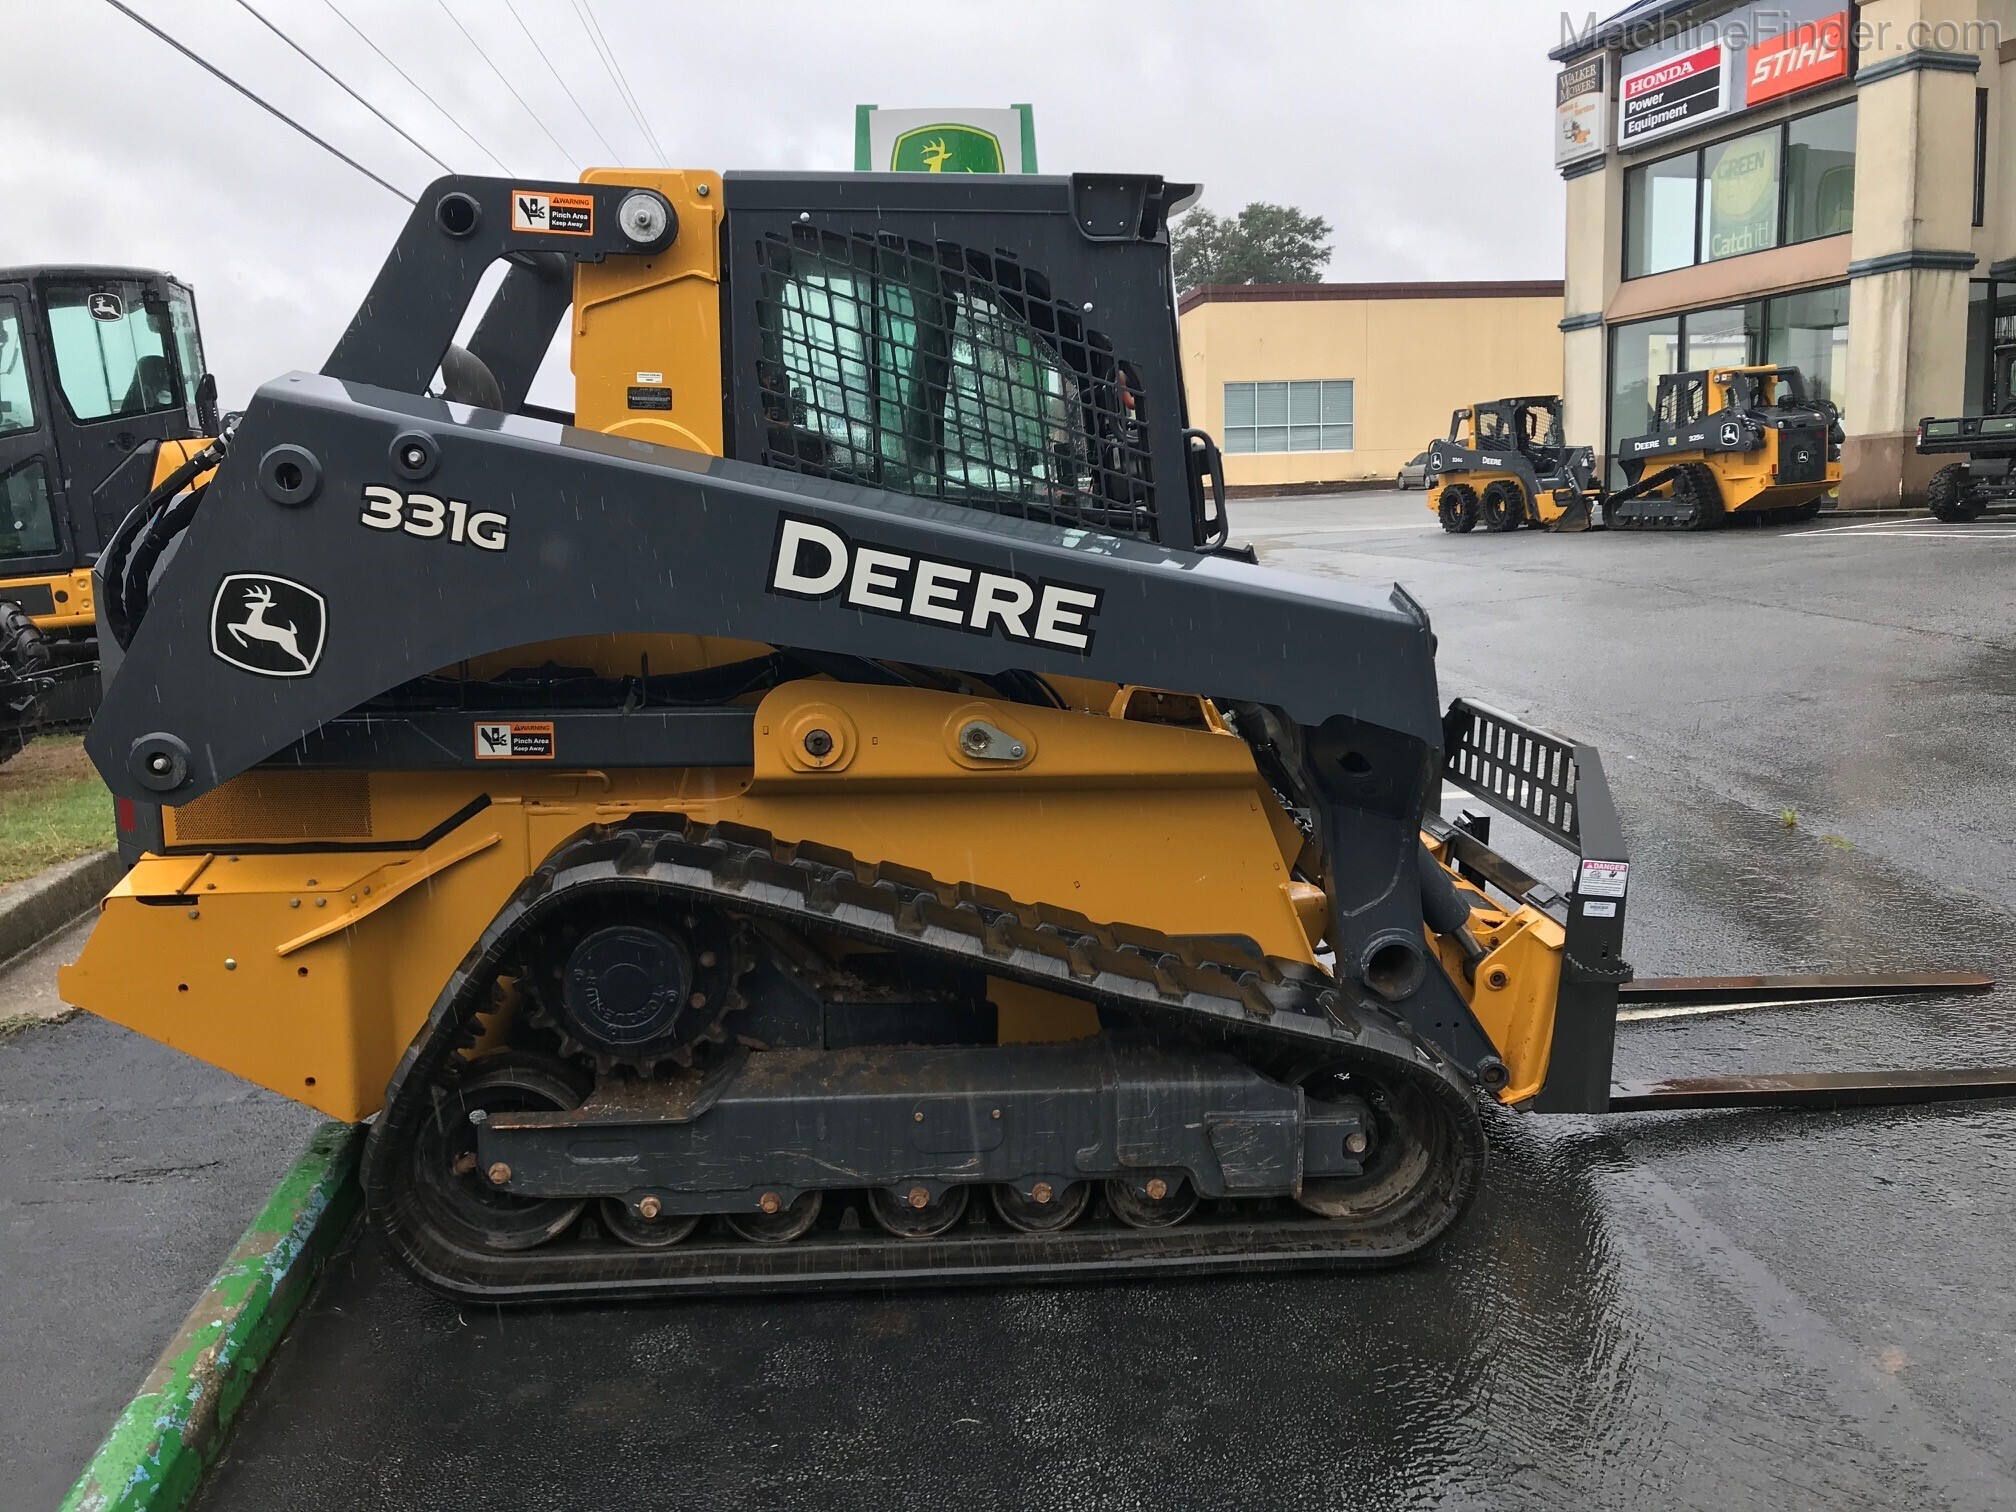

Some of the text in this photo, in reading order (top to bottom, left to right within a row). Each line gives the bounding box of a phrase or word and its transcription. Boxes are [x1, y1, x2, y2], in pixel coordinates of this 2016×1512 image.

[1751, 34, 1837, 87] STIHL
[1560, 64, 1597, 89] WALKER
[1629, 61, 1694, 95] HONDA
[1560, 78, 1596, 103] MOWERS
[1628, 92, 1664, 114] Power
[1628, 103, 1688, 134] Equipment
[1717, 149, 1765, 179] GREEN
[559, 197, 589, 205] WARNING
[552, 211, 571, 219] Pinch
[567, 221, 583, 229] Away
[1712, 221, 1768, 257] Catch it!
[1635, 440, 1660, 451] DEERE
[1482, 456, 1502, 466] DEERE
[361, 486, 508, 551] 331G
[773, 519, 1097, 649] DEERE
[1593, 863, 1626, 871] DANGER
